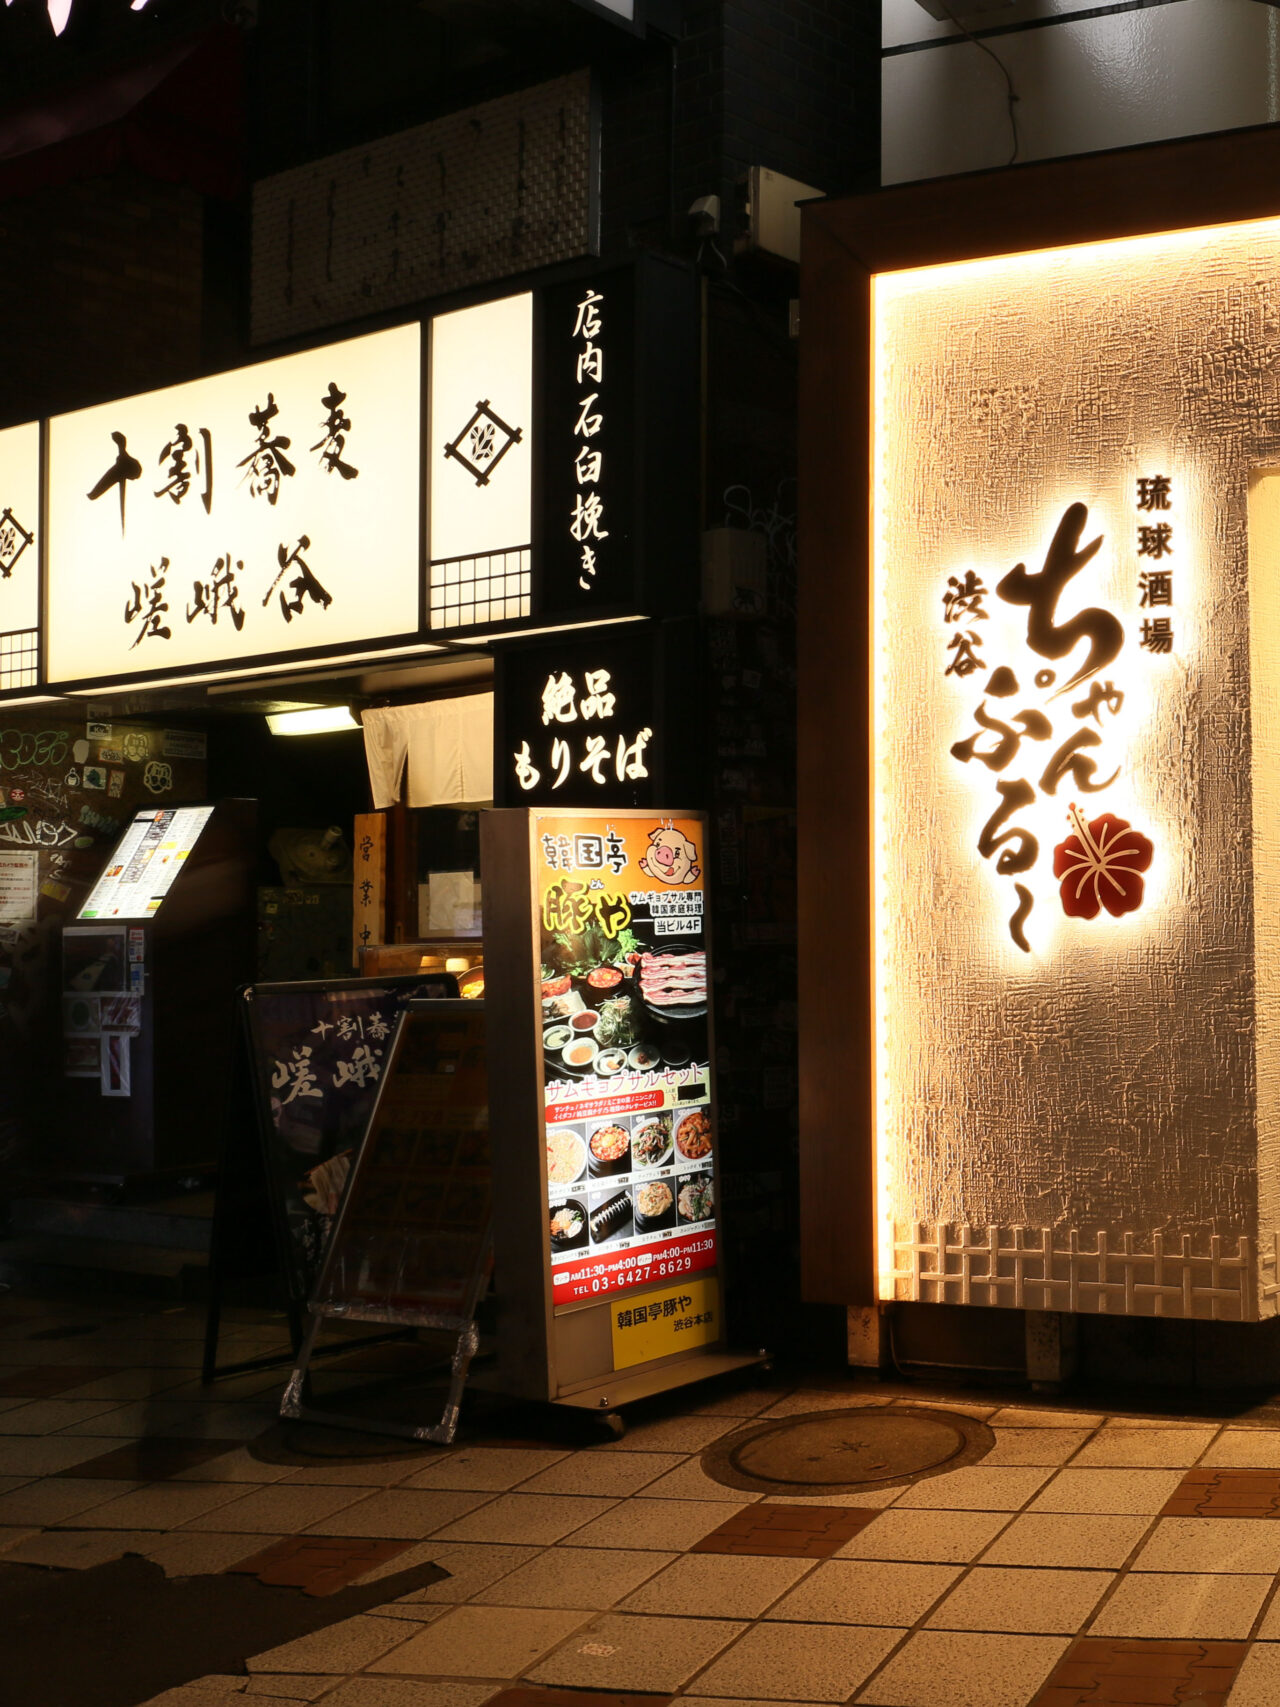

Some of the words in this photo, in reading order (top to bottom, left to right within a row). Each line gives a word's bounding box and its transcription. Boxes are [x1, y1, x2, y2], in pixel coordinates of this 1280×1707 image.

[86, 381, 359, 540] 十割蕎麦
[569, 288, 609, 591] 店内石臼挽き
[124, 533, 333, 652] 嵯峨谷
[1137, 474, 1174, 654] 琉球酒場
[941, 569, 990, 677] 渋谷
[540, 669, 617, 727] 絶品
[513, 727, 653, 791] もりそば
[541, 832, 627, 873] 韓国亭
[543, 876, 631, 939] 豚や
[656, 918, 701, 933] 当ビル4F
[310, 1010, 399, 1041] 十割蕎
[546, 1062, 703, 1102] サムギョプサルセット
[573, 1286, 589, 1295] TEL
[592, 1257, 692, 1292] 03-6427-8629
[616, 1295, 692, 1330] 韓国亭豚や
[673, 1312, 714, 1333] 渋谷本店
